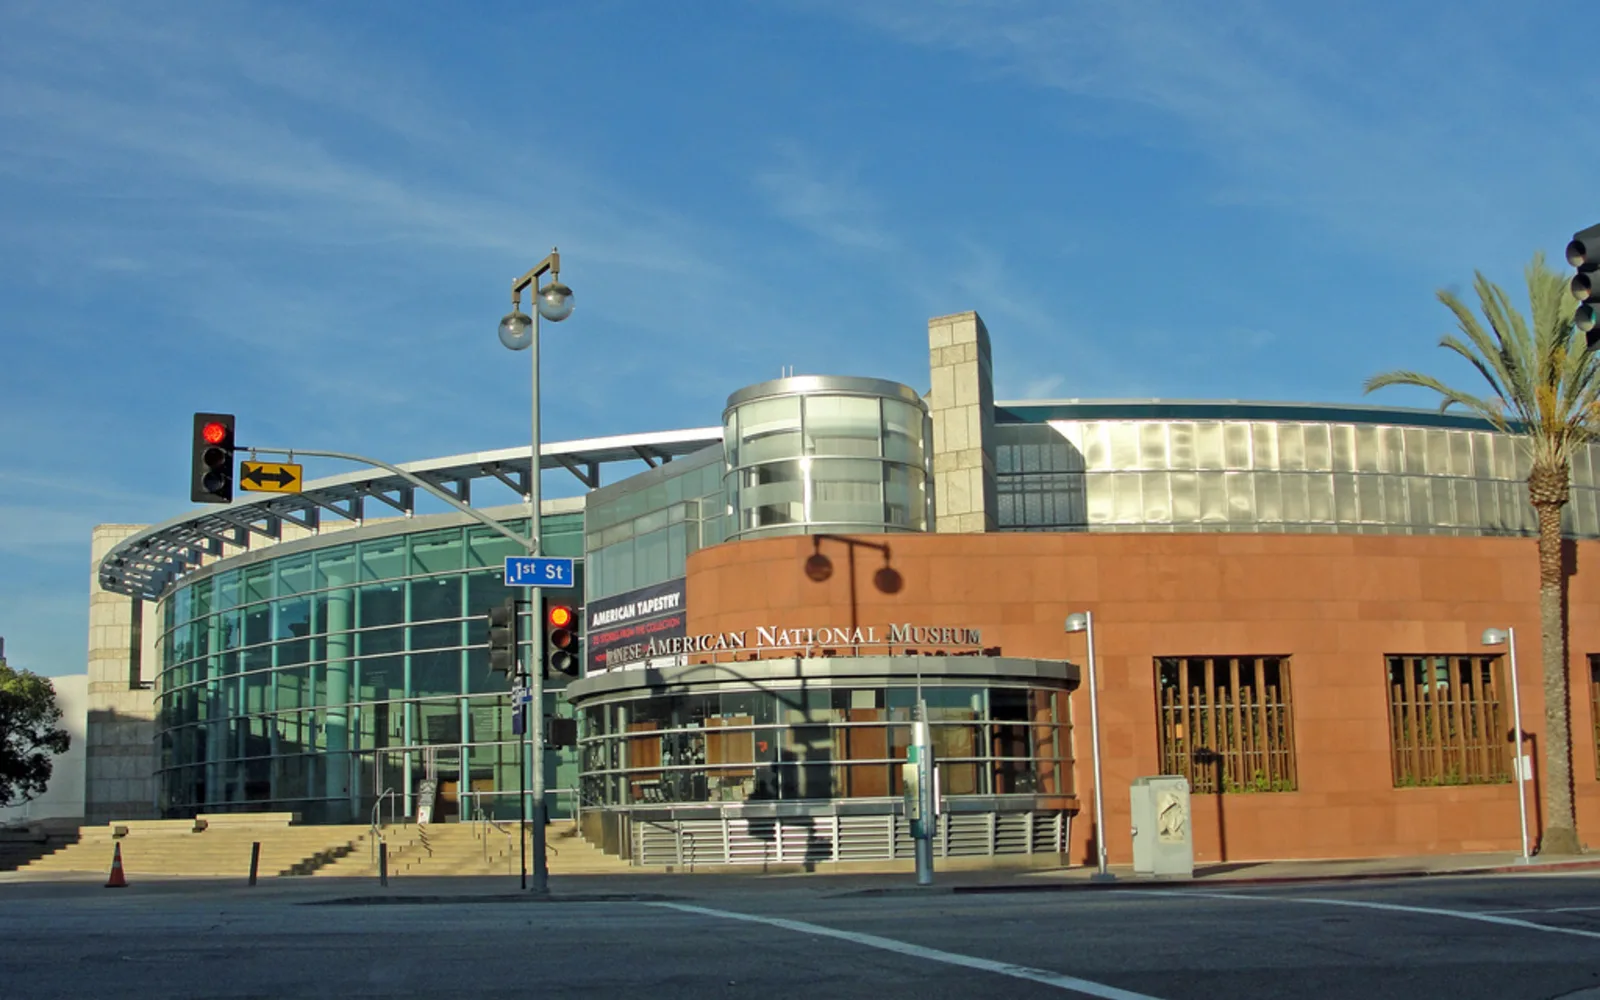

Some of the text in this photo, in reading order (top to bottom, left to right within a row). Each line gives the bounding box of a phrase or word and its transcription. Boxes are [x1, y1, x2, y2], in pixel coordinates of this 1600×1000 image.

[515, 562, 563, 580] 1st St
[592, 592, 680, 627] AMERICAN TAPESTRY
[646, 630, 745, 657] AMERICAN
[756, 625, 880, 647] NATIONAL
[890, 623, 981, 645] MUSEUM
